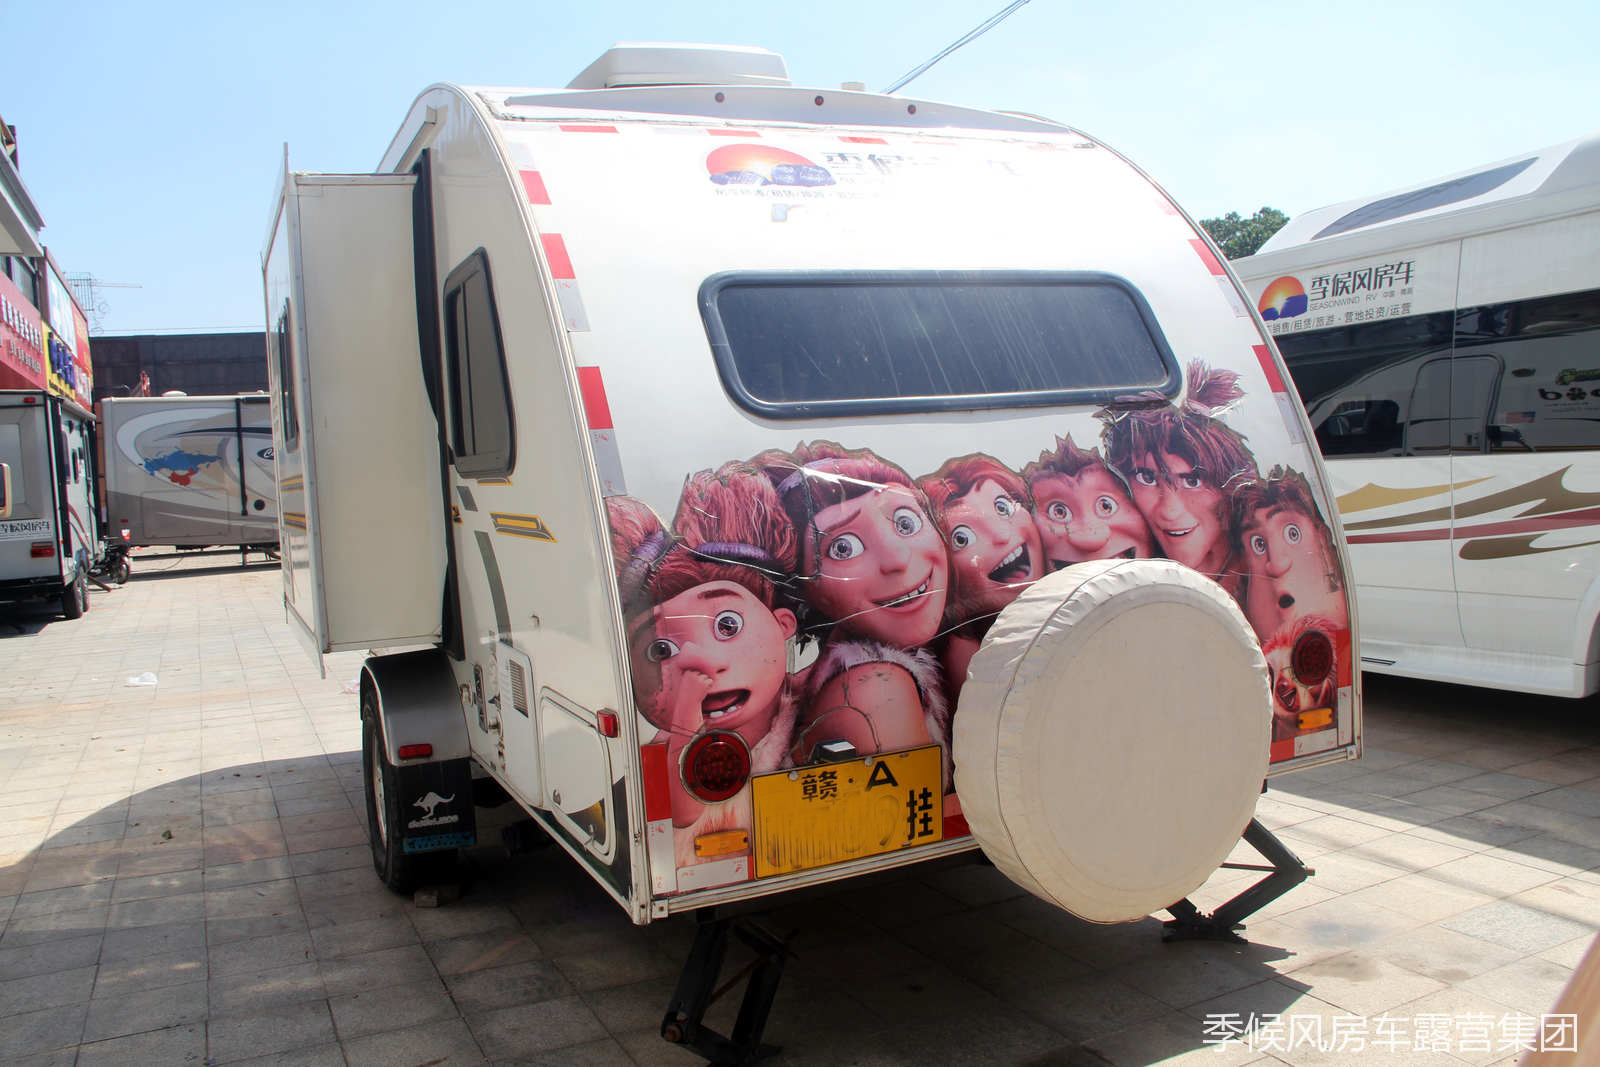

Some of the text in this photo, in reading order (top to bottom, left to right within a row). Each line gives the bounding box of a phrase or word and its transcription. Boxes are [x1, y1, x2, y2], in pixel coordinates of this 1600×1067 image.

[1310, 260, 1416, 302] 季候风房车
[906, 787, 934, 841] 挂
